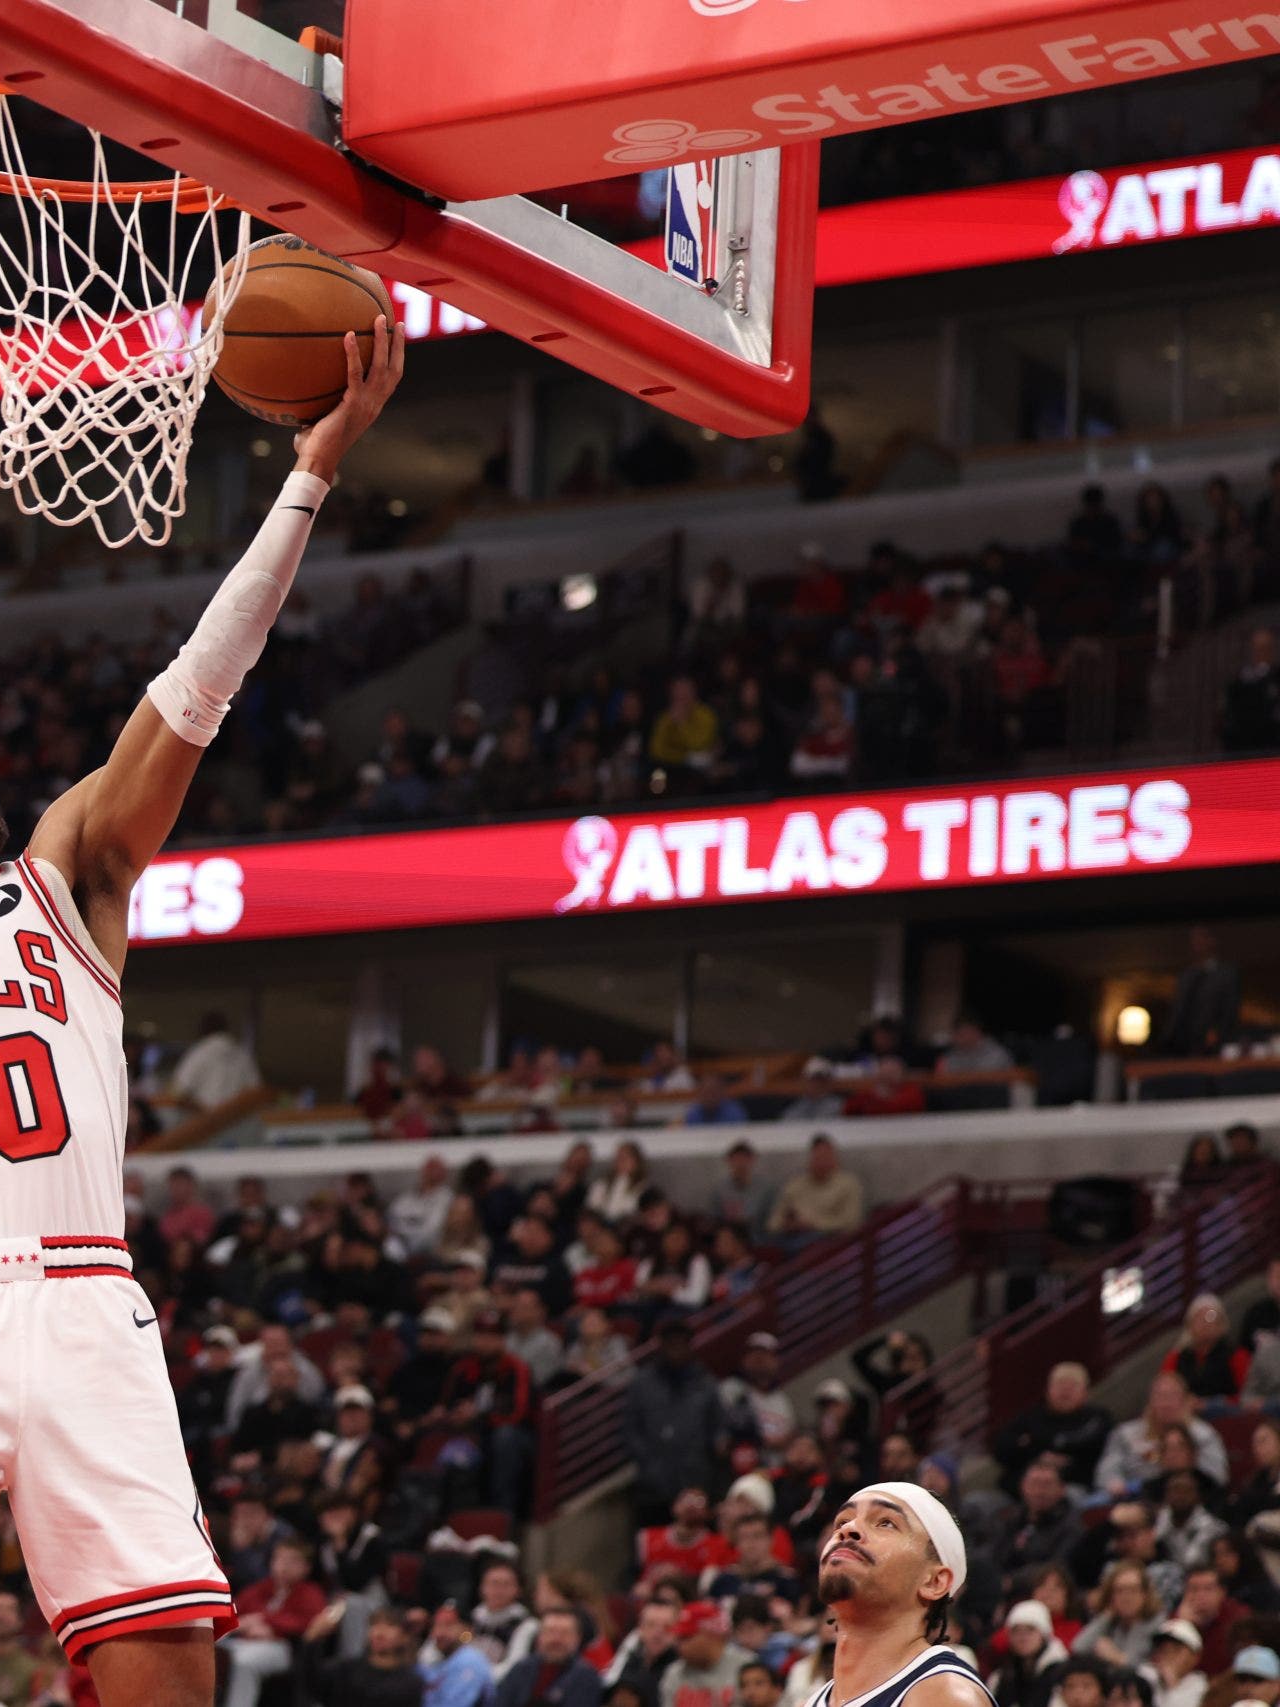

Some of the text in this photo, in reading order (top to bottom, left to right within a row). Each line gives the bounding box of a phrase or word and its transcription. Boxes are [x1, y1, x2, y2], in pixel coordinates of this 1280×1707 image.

[1099, 154, 1280, 245] ATLA
[672, 231, 694, 271] NBA
[608, 780, 1192, 905] ATLAS TIRES
